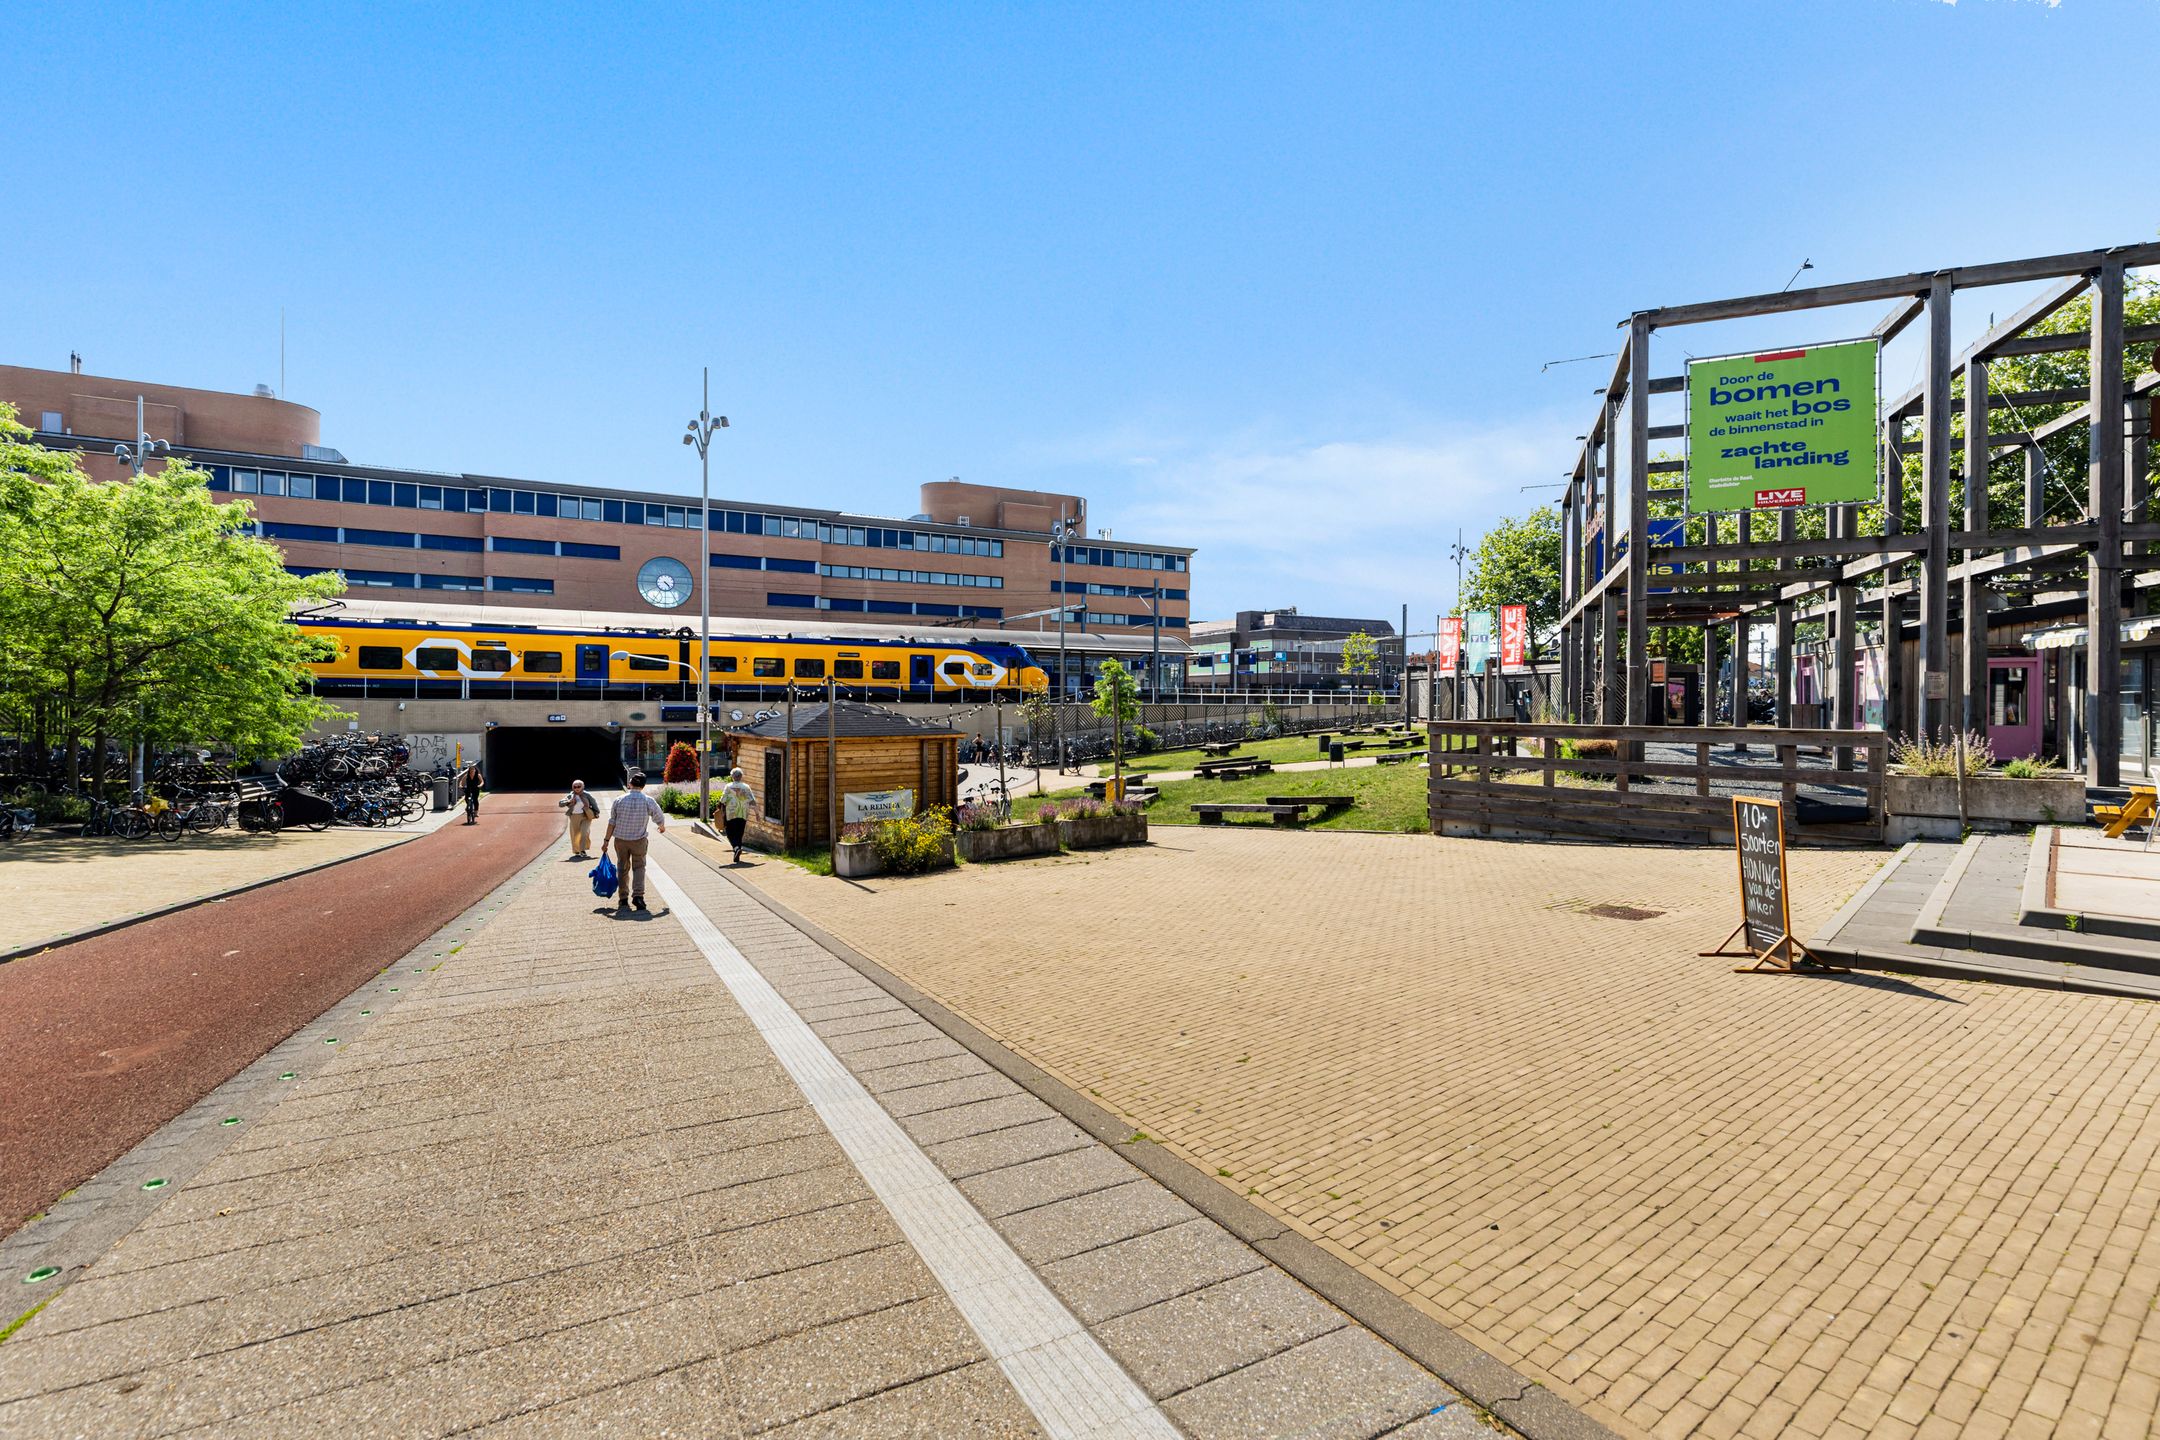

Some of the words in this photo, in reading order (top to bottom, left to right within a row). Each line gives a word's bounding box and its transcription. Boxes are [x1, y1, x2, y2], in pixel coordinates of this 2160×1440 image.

[1719, 374, 1754, 386] Door
[1757, 371, 1775, 381] de
[1709, 377, 1840, 406] bomen
[1725, 411, 1762, 423] waait
[1765, 408, 1789, 419] het
[1791, 399, 1851, 416] bos
[1709, 427, 1726, 437] de
[1728, 418, 1808, 435] binnenstad
[1810, 417, 1824, 427] in
[1721, 440, 1807, 459] zachte
[1754, 449, 1850, 470] landing
[1757, 489, 1803, 501] LIVE
[1757, 497, 1803, 505] HILVERSUM
[1504, 608, 1517, 663] LIVE
[344, 645, 350, 653] 2
[517, 650, 523, 658] 2
[1742, 803, 1768, 829] 10+
[1741, 832, 1781, 856] Soorten
[1742, 857, 1781, 889] HONING
[1748, 882, 1763, 896] van
[1765, 887, 1776, 900] de
